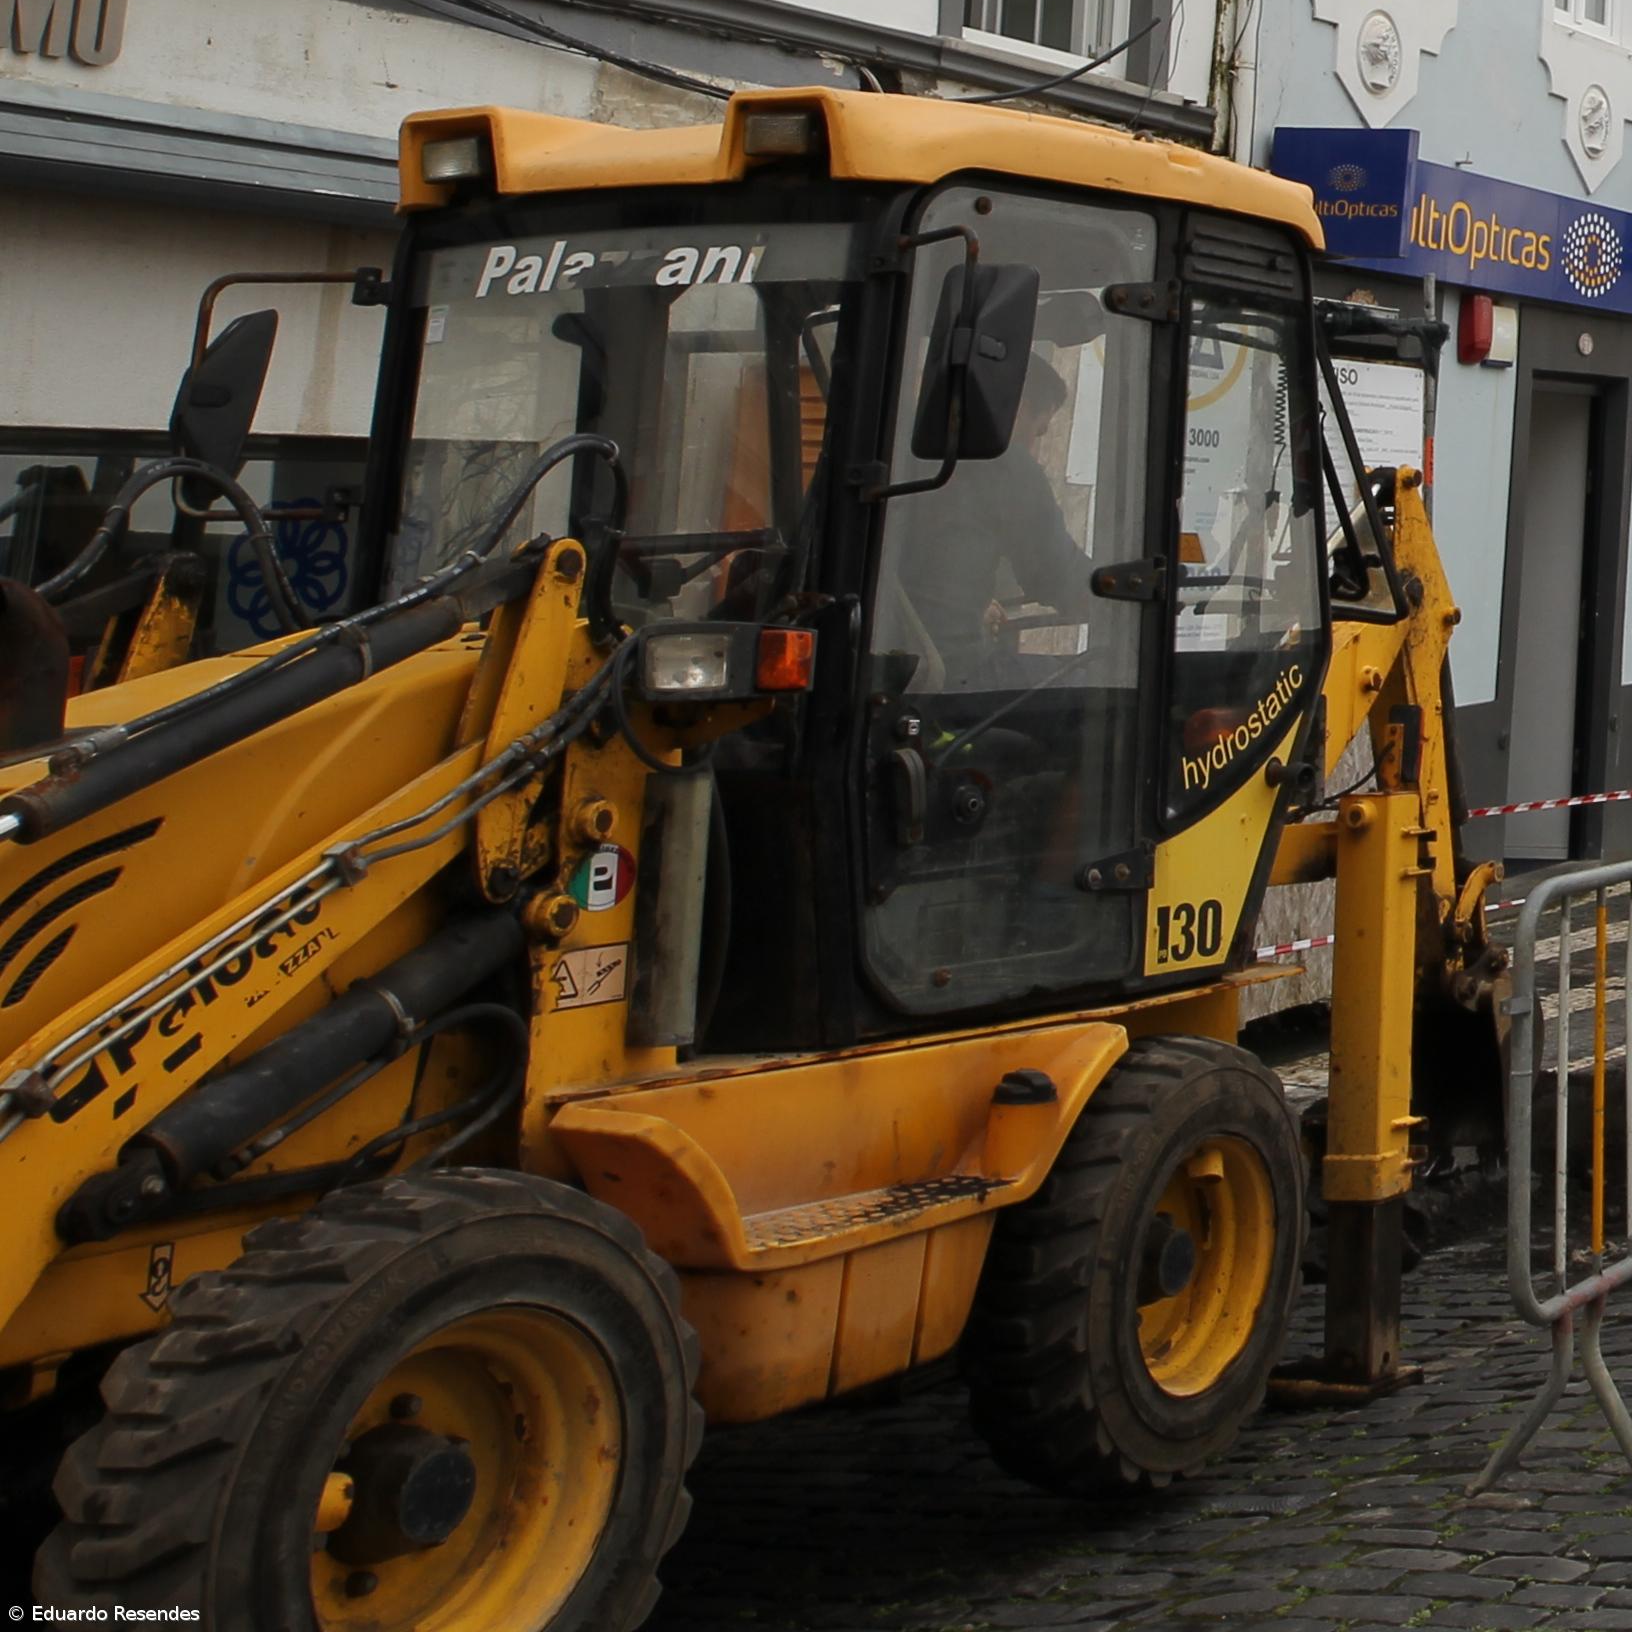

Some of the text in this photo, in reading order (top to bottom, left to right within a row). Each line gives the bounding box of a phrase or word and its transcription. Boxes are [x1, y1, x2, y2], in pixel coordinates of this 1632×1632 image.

[1313, 199, 1399, 220] ltiOpticas
[475, 234, 767, 299] Palaani
[1181, 663, 1303, 791] hydrostatic
[1156, 898, 1224, 965] 130
